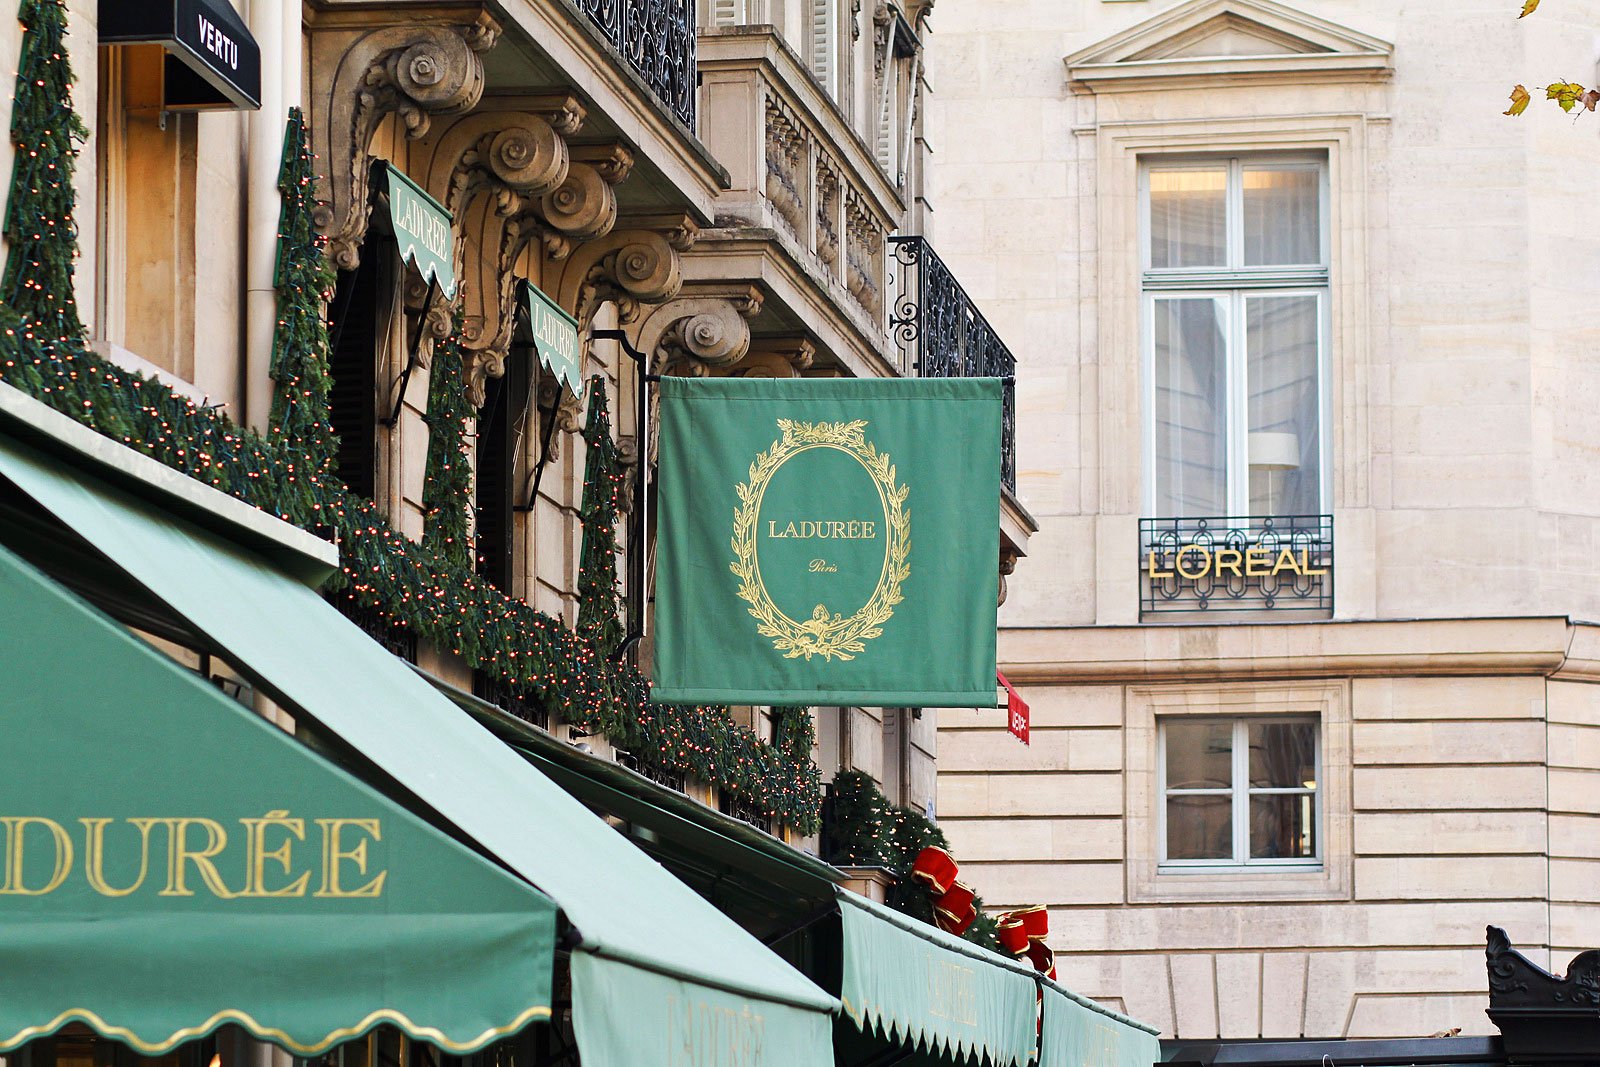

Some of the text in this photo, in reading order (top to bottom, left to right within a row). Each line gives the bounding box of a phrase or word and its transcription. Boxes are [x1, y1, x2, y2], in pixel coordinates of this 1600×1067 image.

[198, 14, 238, 71] VERTU
[396, 188, 447, 262] LADURÉE
[768, 520, 876, 539] LADURÉE
[808, 558, 838, 573] Paris
[1149, 542, 1328, 580] L'ORÉAL
